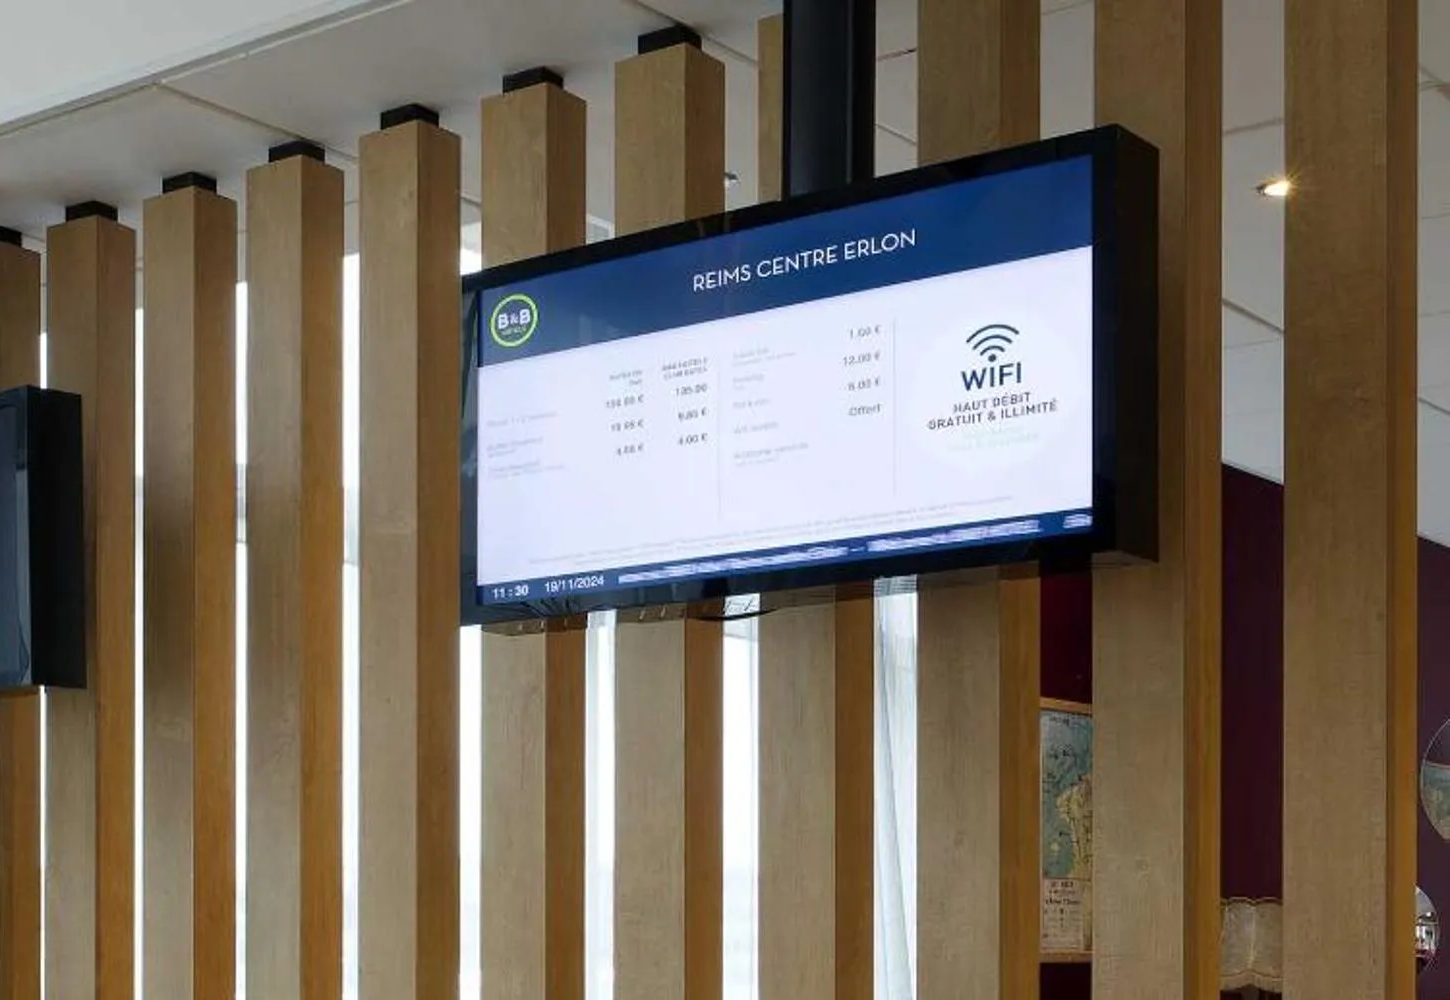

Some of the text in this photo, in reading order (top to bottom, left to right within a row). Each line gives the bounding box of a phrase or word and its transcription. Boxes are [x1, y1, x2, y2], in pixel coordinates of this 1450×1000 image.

[692, 228, 917, 293] REIMS CENTRE ERLON
[497, 308, 532, 330] B&B
[960, 361, 1022, 392] WIFI
[927, 397, 1057, 430] GRATUIT & ILLIMITÉ
[952, 391, 1031, 414] HAUT DÉBIT
[544, 575, 605, 593] 19/11/2024
